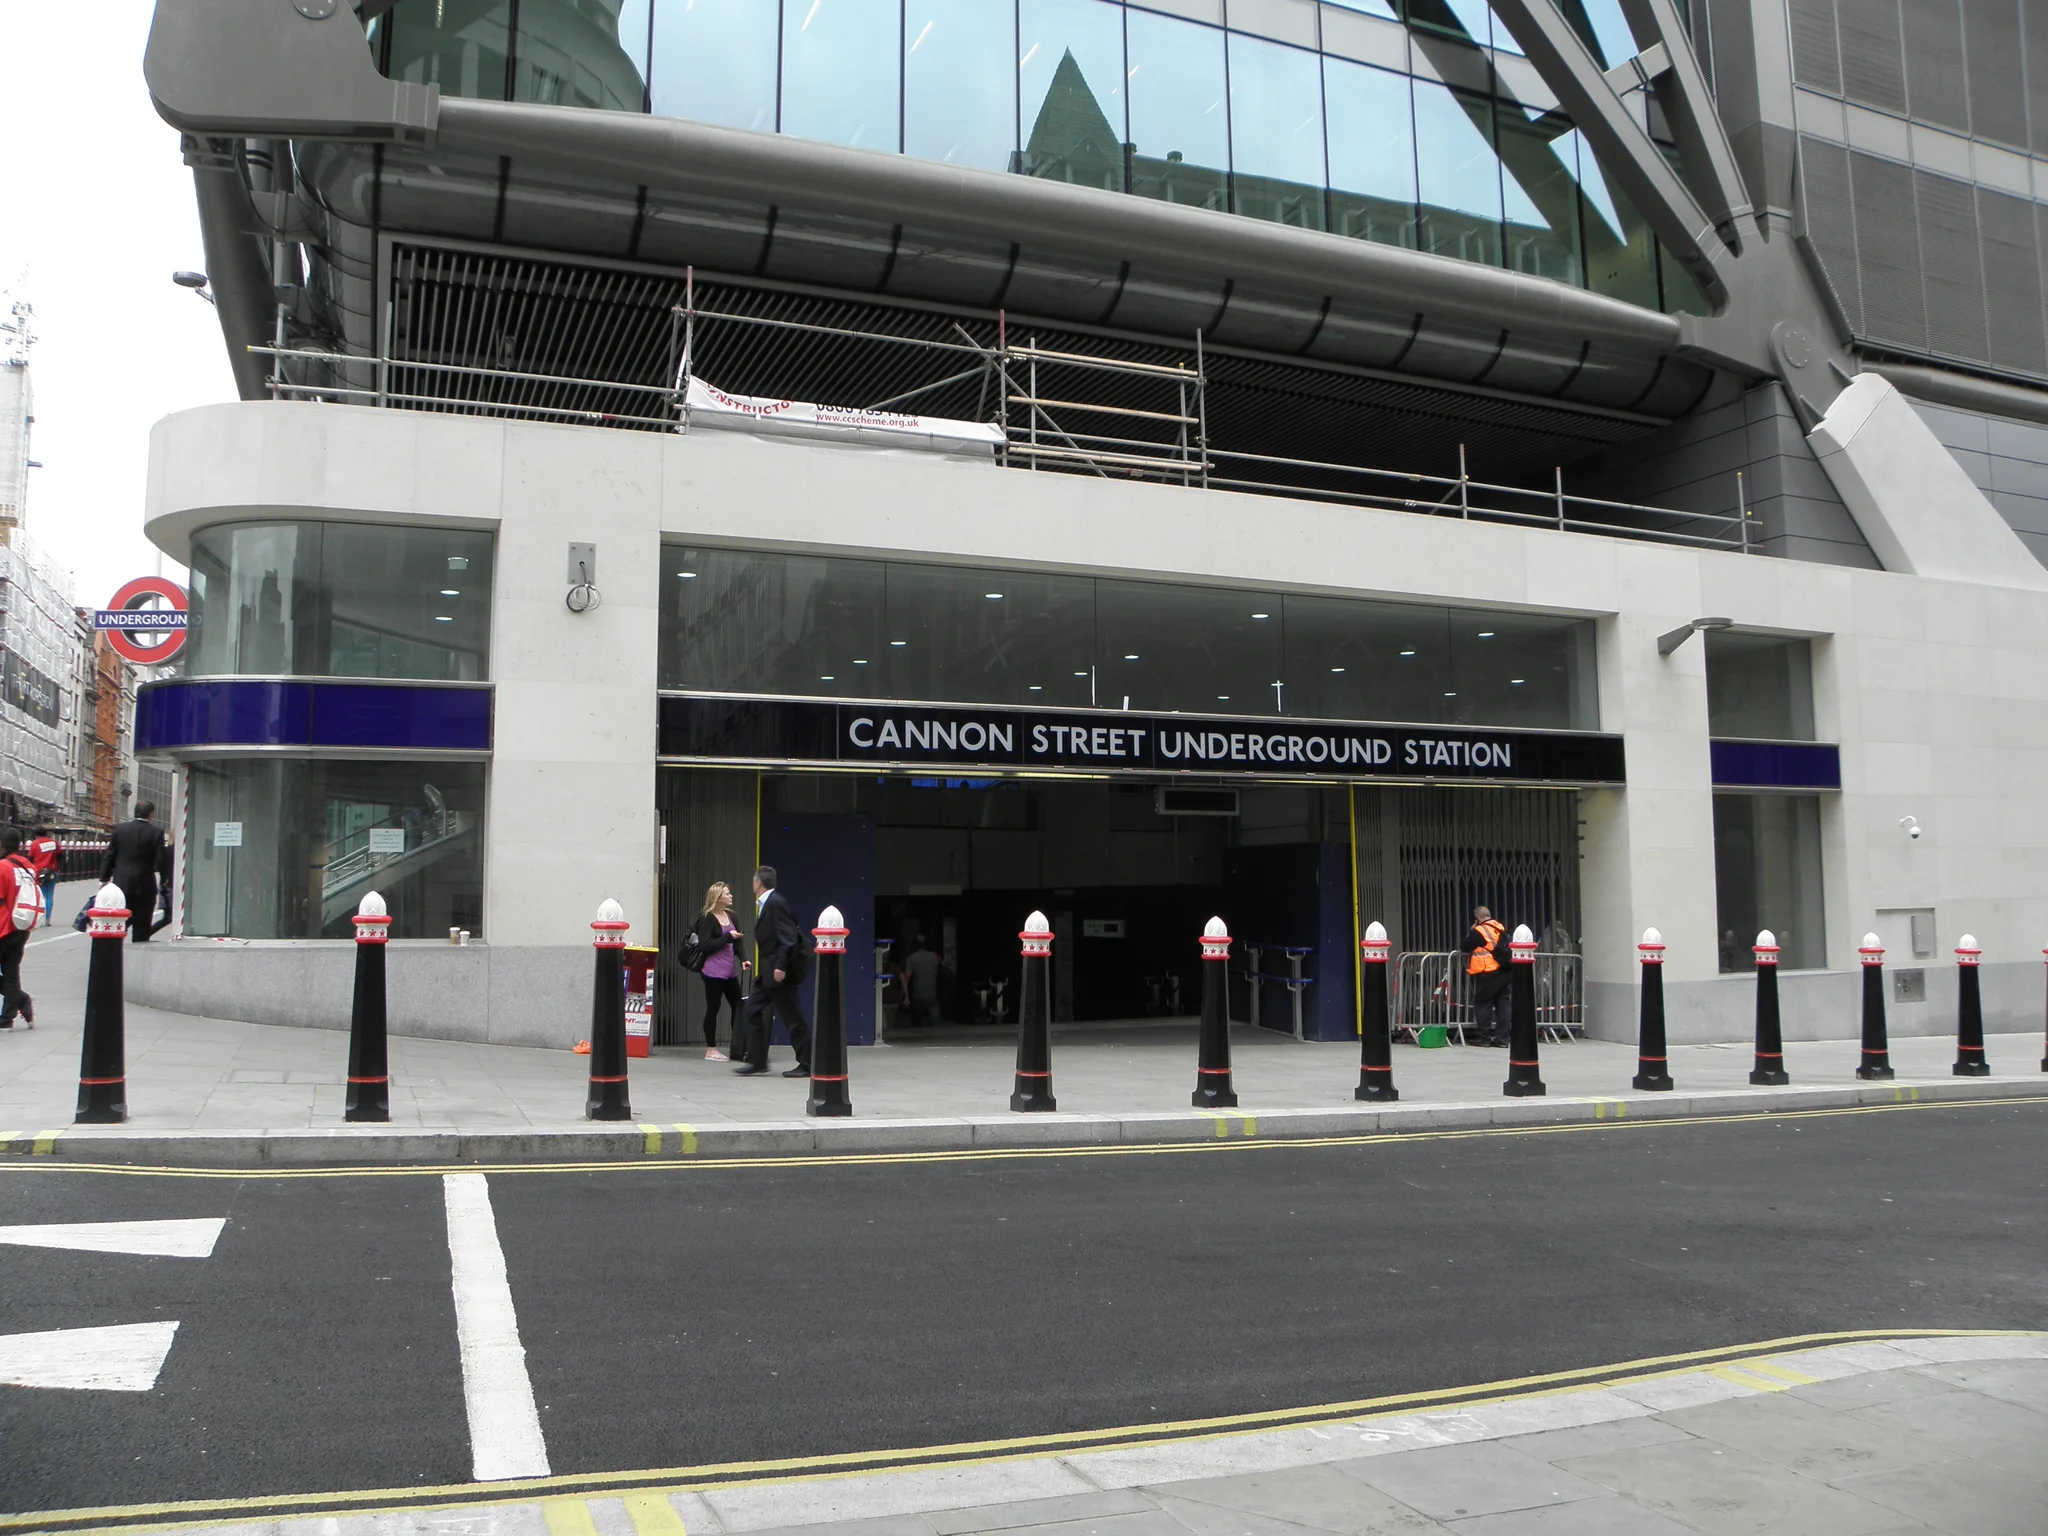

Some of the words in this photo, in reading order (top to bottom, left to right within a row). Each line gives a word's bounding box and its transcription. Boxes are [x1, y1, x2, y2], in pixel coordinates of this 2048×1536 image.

[815, 413, 919, 428] www.ccscheme.org.uk
[849, 718, 1013, 751] CANNON
[1032, 725, 1146, 756] STREET
[1160, 731, 1391, 764] UNDERGROUND
[1404, 740, 1511, 767] STATION
